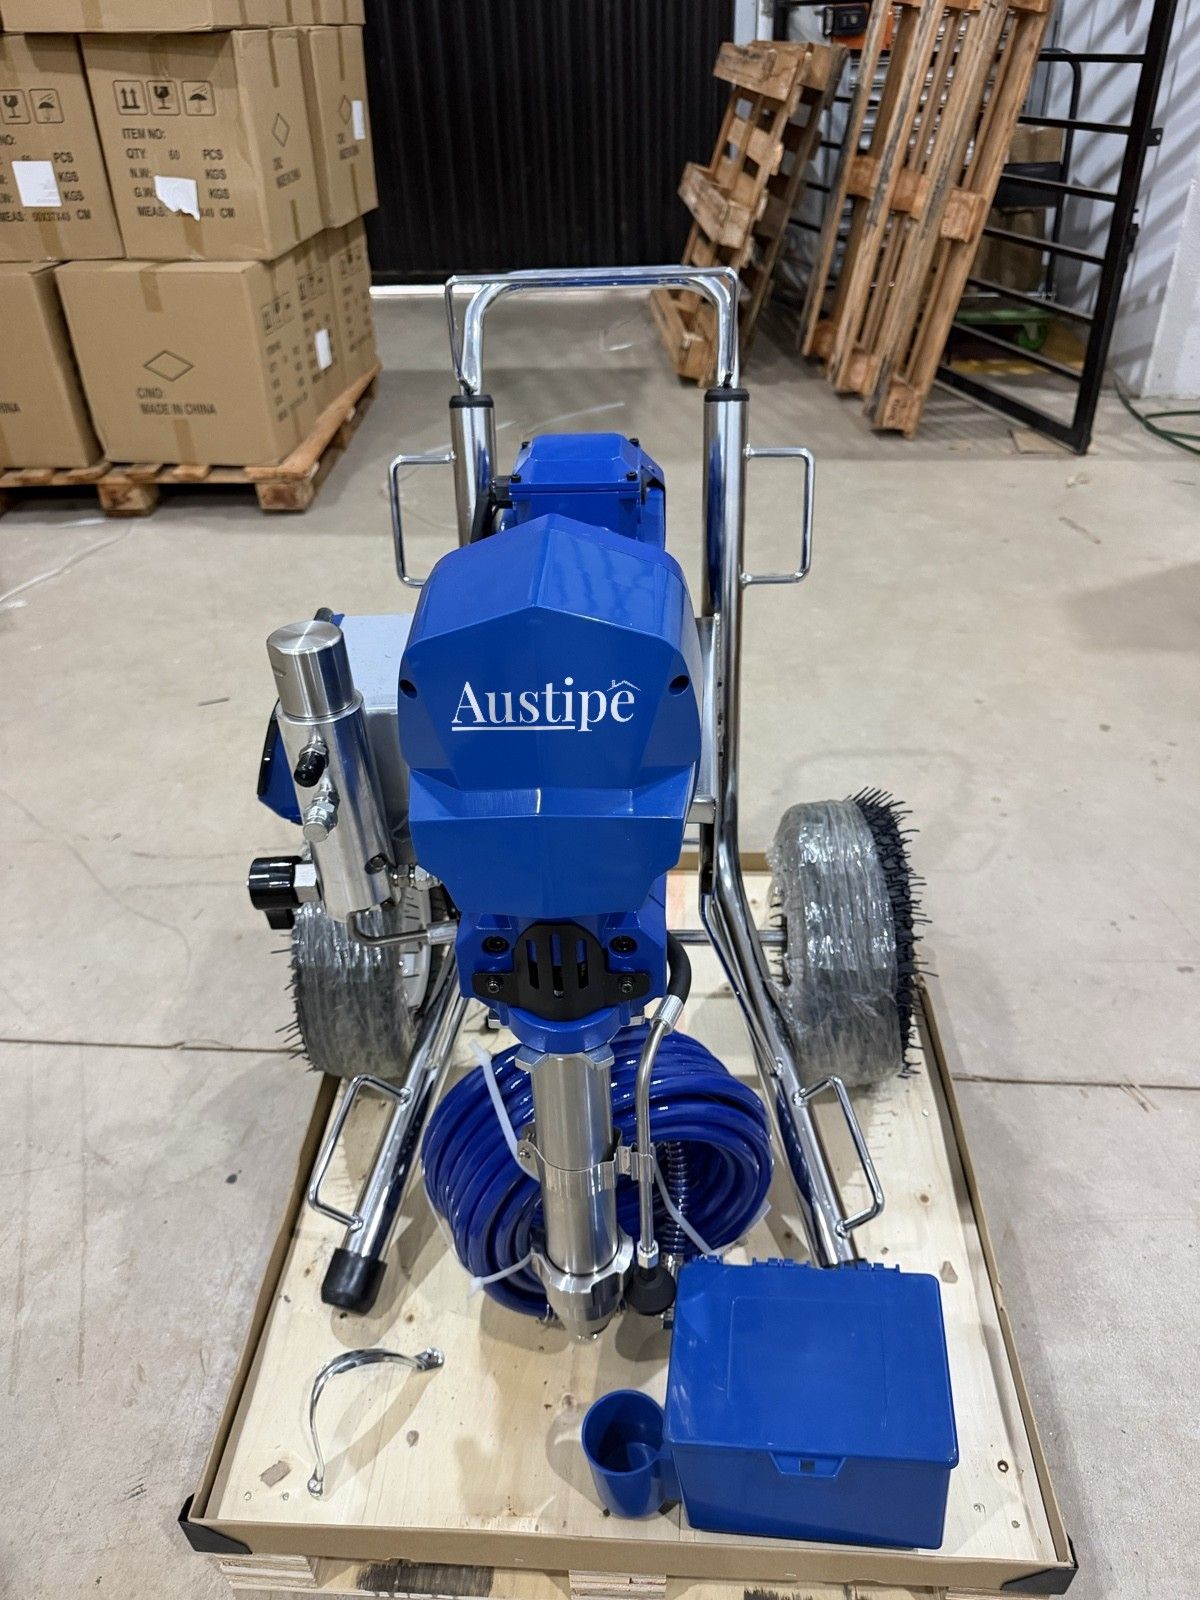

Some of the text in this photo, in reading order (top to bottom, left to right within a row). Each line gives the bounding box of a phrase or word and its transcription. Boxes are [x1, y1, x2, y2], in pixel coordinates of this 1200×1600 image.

[122, 128, 146, 139] ITEM
[53, 152, 74, 163] PCS
[203, 149, 224, 160] PCS
[58, 172, 79, 182] KGS
[205, 169, 227, 180] KGS
[63, 191, 84, 201] KGS
[209, 188, 230, 199] KGS
[77, 209, 91, 219] CM
[220, 208, 235, 218] CM
[141, 403, 217, 415] MADE IN CHINA
